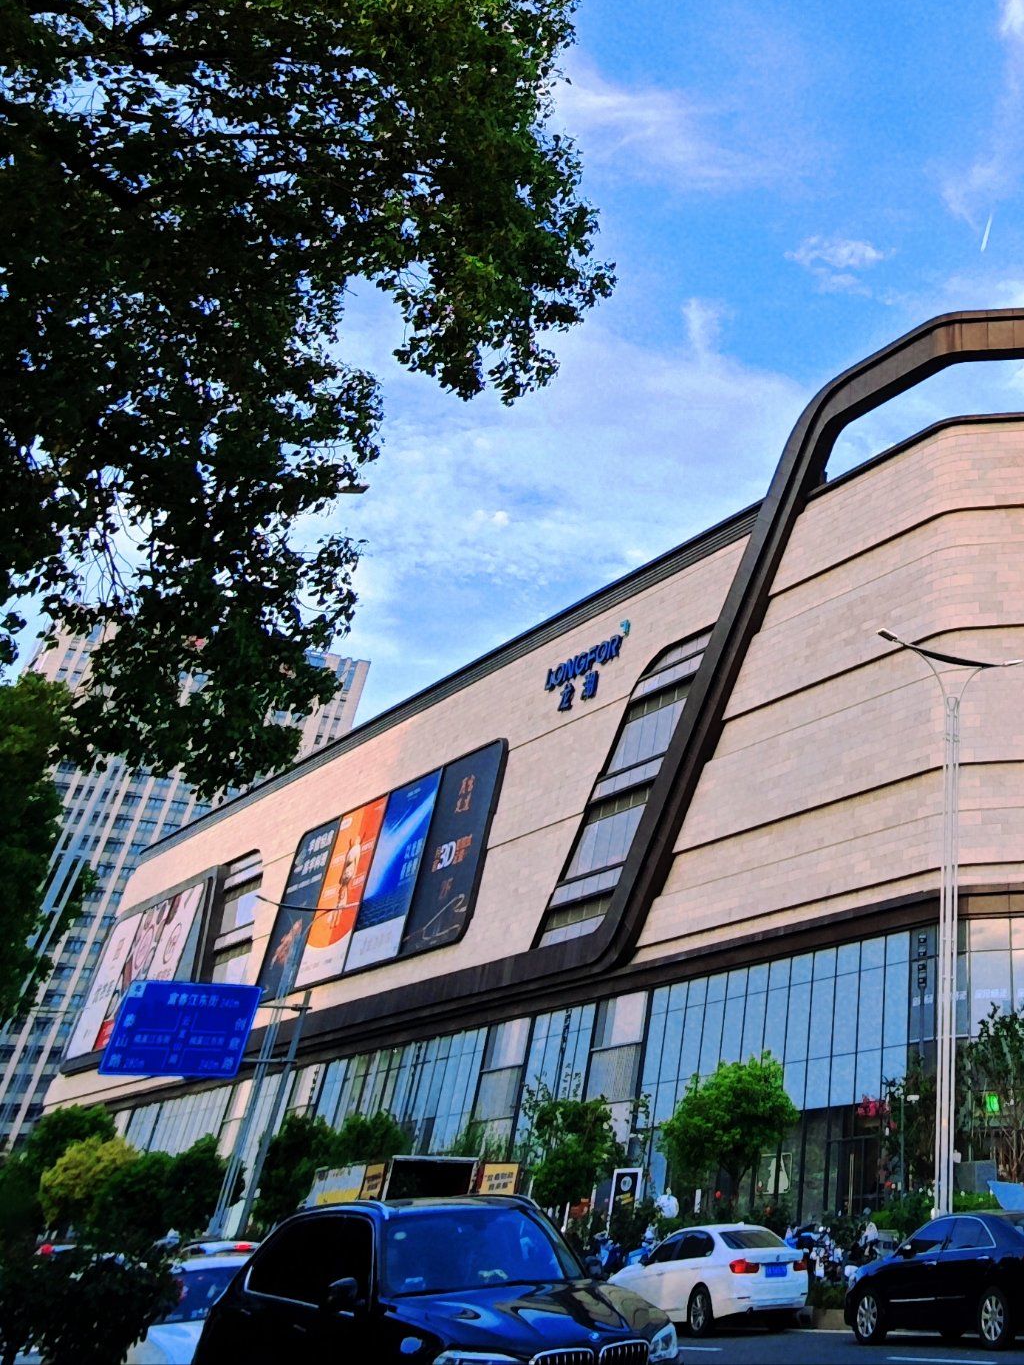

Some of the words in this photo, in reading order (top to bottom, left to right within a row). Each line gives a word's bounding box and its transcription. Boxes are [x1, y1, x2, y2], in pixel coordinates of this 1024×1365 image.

[544, 634, 624, 693] LONGFOR
[557, 670, 600, 713] 龙湖
[437, 840, 457, 870] 3D
